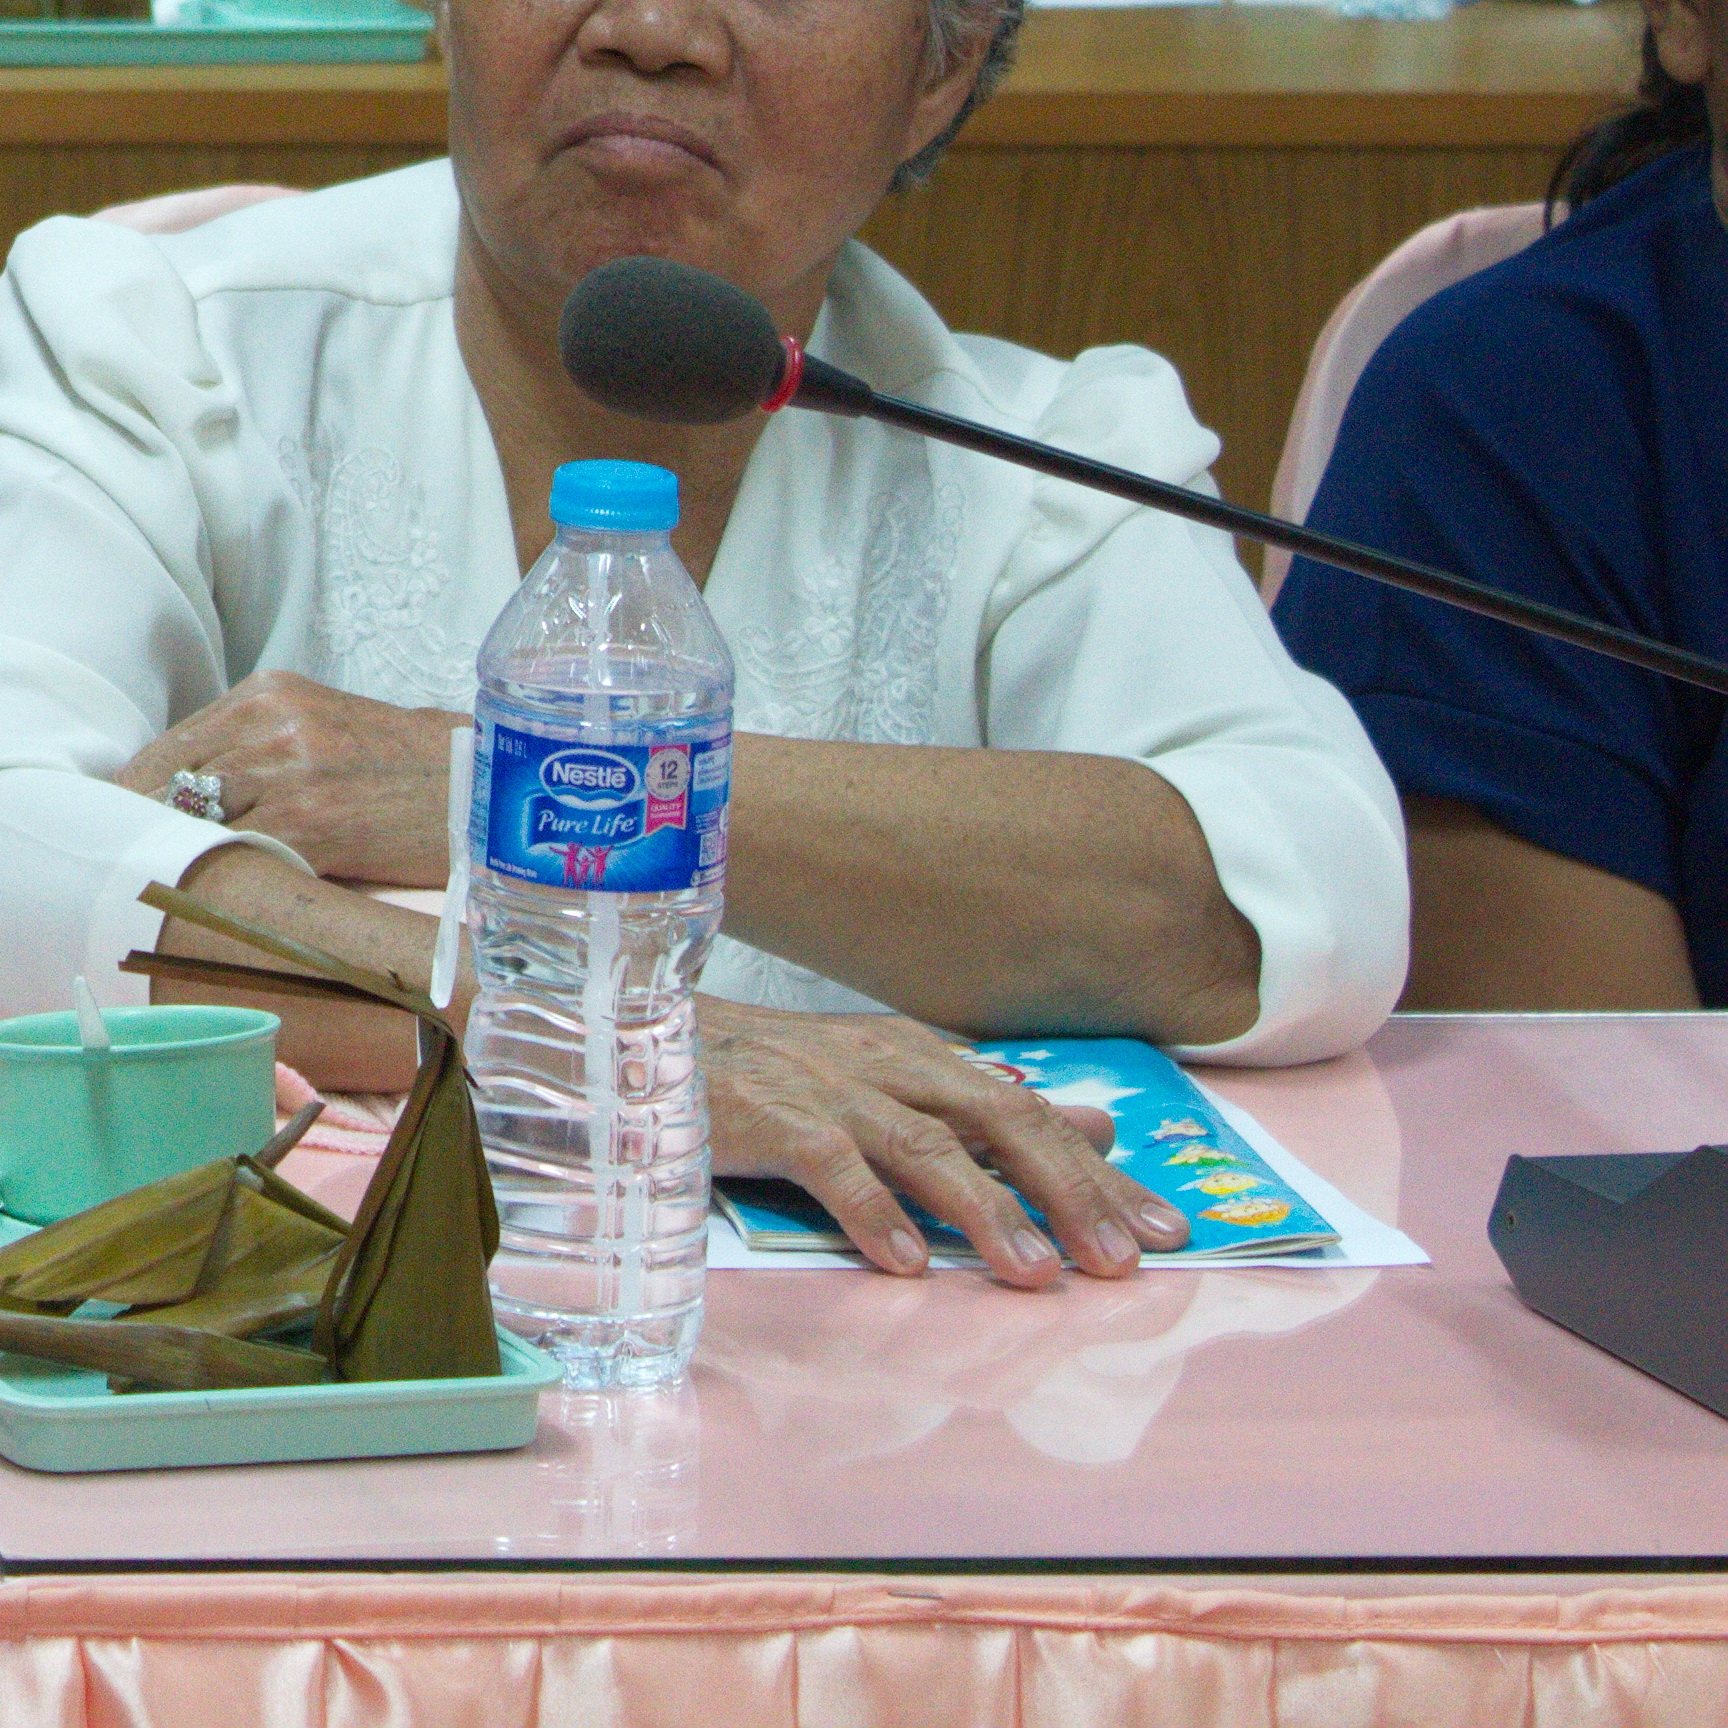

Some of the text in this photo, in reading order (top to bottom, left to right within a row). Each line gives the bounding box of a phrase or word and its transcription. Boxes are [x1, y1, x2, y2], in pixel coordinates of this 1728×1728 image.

[659, 760, 678, 780] 12
[538, 809, 635, 837] Pure Life
